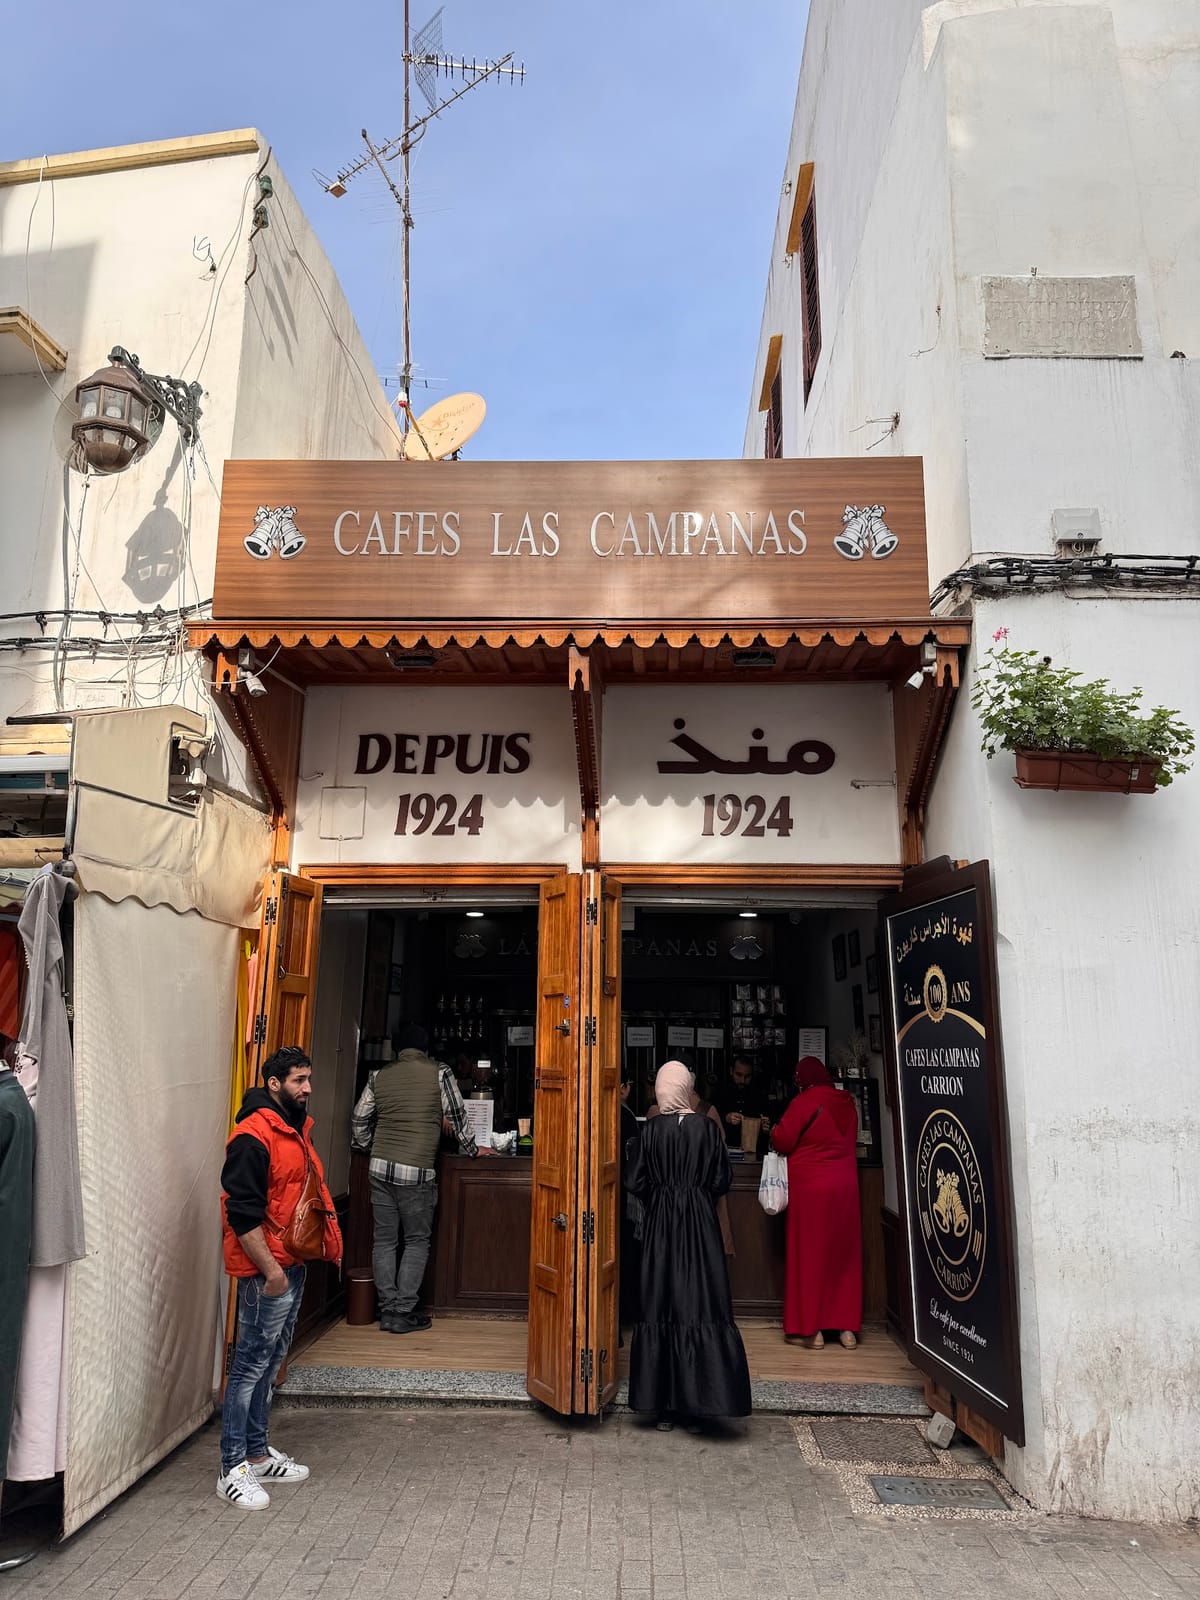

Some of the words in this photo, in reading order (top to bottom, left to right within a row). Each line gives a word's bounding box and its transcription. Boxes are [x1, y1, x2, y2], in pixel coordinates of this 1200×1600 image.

[333, 510, 461, 557] CAFES
[491, 511, 560, 557] LAS
[590, 509, 808, 557] CAMPANAS
[354, 732, 532, 775] DEPUIS
[657, 718, 836, 775] منذ
[394, 793, 484, 837] 1924
[701, 794, 794, 837] 1924
[919, 911, 950, 943] الأجراس
[952, 917, 974, 947] قهوة
[496, 938, 537, 956] LA
[903, 983, 921, 1005] سنة
[929, 984, 942, 1004] 100
[951, 981, 971, 1004] ANS
[905, 1048, 925, 1068] CAFES
[926, 1048, 939, 1067] LAS
[939, 1047, 980, 1069] CAMPANAS
[920, 1075, 964, 1096] CARRION
[919, 1136, 932, 1188] CAFES
[929, 1121, 943, 1143] LAS
[943, 1121, 981, 1204] CAMPANAS
[936, 1256, 973, 1292] CARRION
[942, 1335, 960, 1355] SINCE
[960, 1347, 975, 1365] 1924
